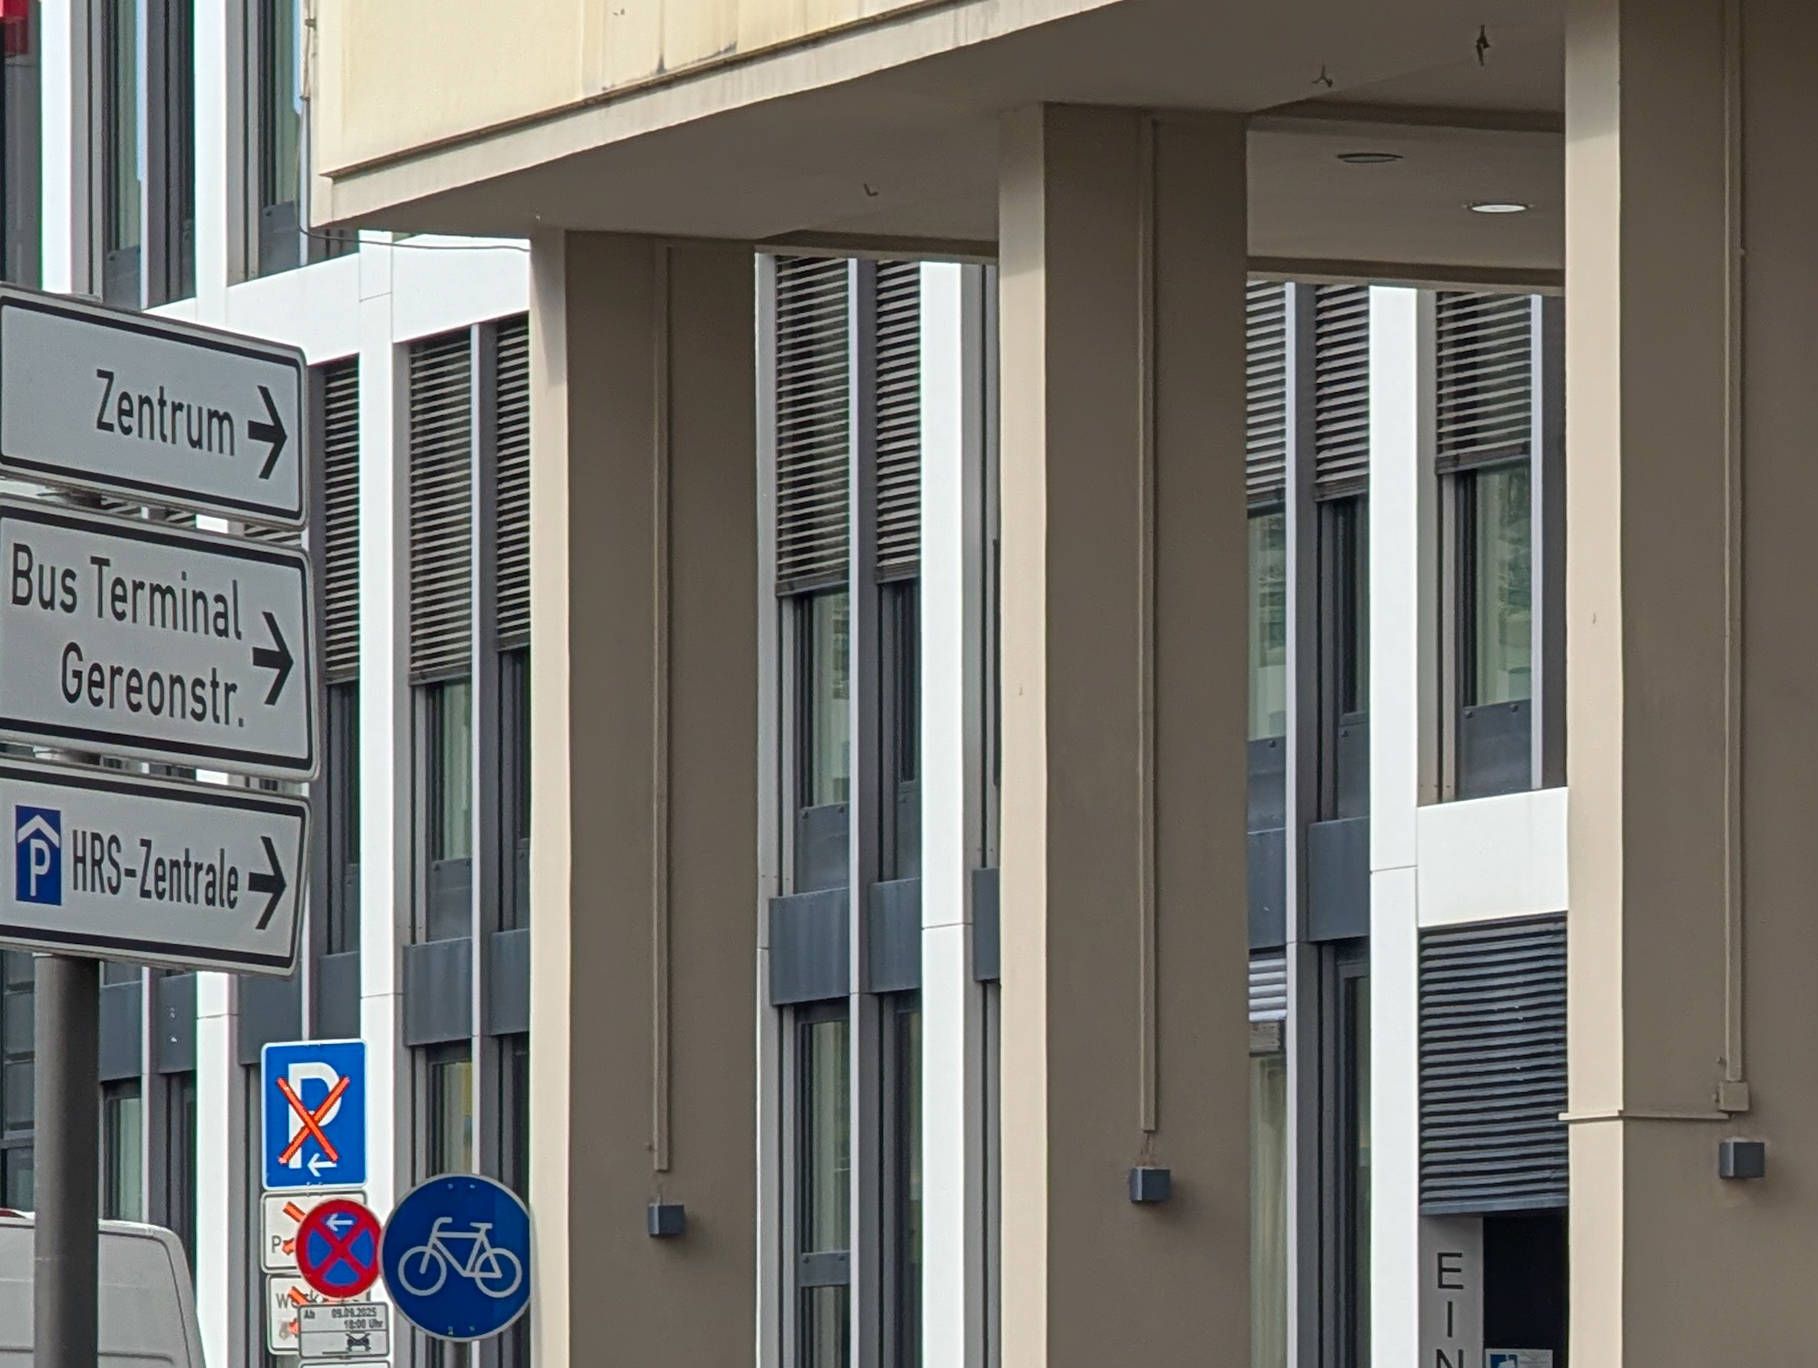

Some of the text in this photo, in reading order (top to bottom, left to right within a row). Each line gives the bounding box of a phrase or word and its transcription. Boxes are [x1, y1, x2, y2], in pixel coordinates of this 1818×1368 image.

[96, 369, 235, 456] Zentrum
[12, 543, 242, 640] Bus Terminal
[62, 642, 244, 727] Gereonstr.
[72, 829, 239, 909] HRS-Zentrale
